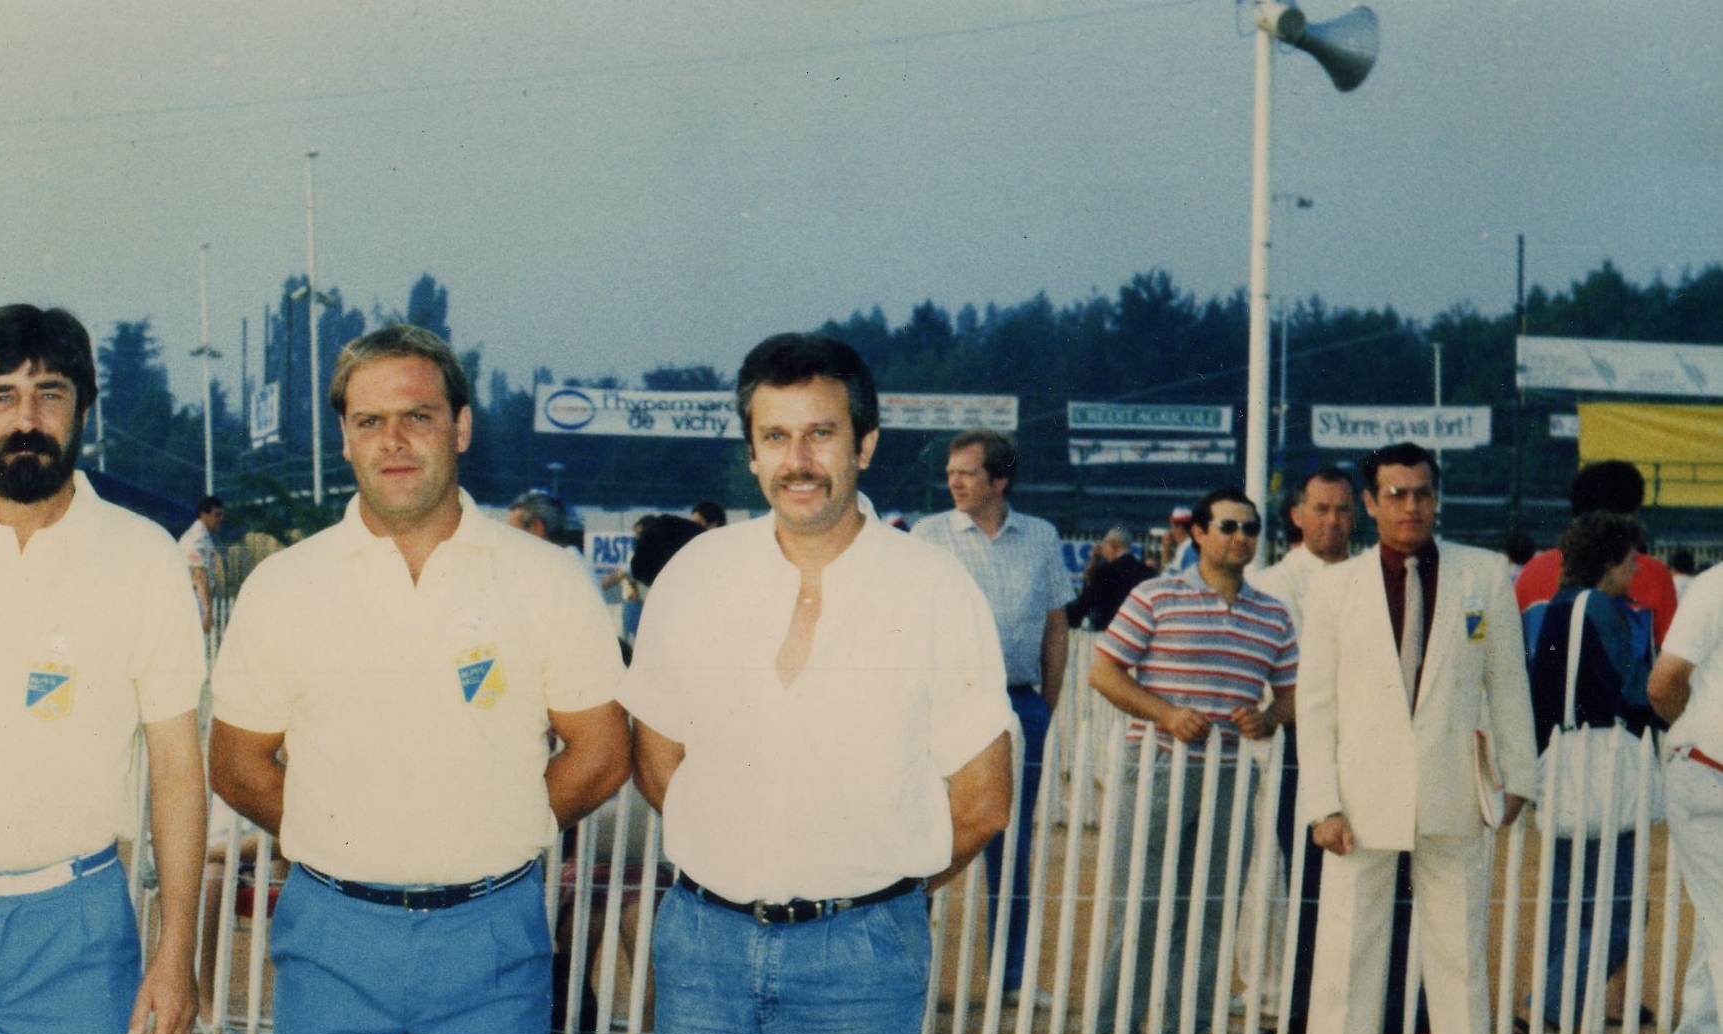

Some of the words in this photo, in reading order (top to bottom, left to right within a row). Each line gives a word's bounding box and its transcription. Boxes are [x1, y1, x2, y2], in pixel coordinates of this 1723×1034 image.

[628, 409, 655, 430] de
[671, 412, 730, 438] vichy
[1410, 420, 1428, 436] va
[593, 535, 637, 564] PAST
